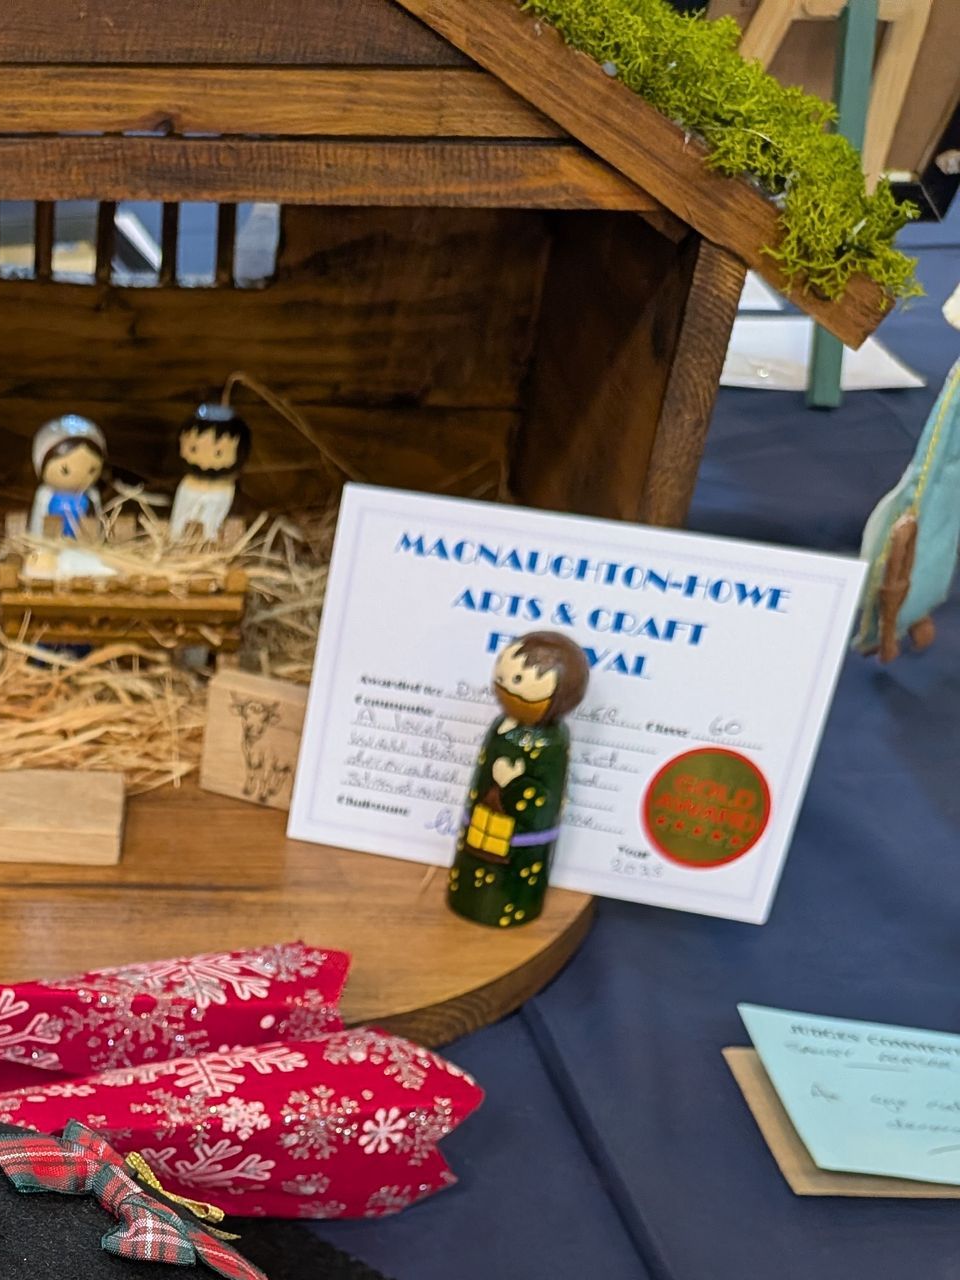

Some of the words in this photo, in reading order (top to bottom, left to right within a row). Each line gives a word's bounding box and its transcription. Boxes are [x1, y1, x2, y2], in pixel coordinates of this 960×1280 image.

[395, 531, 792, 614] MACNAUGHTON-HOWE
[452, 589, 543, 622] ARTS
[550, 602, 574, 627] &
[589, 608, 708, 647] CRAFT
[708, 714, 743, 737] 60
